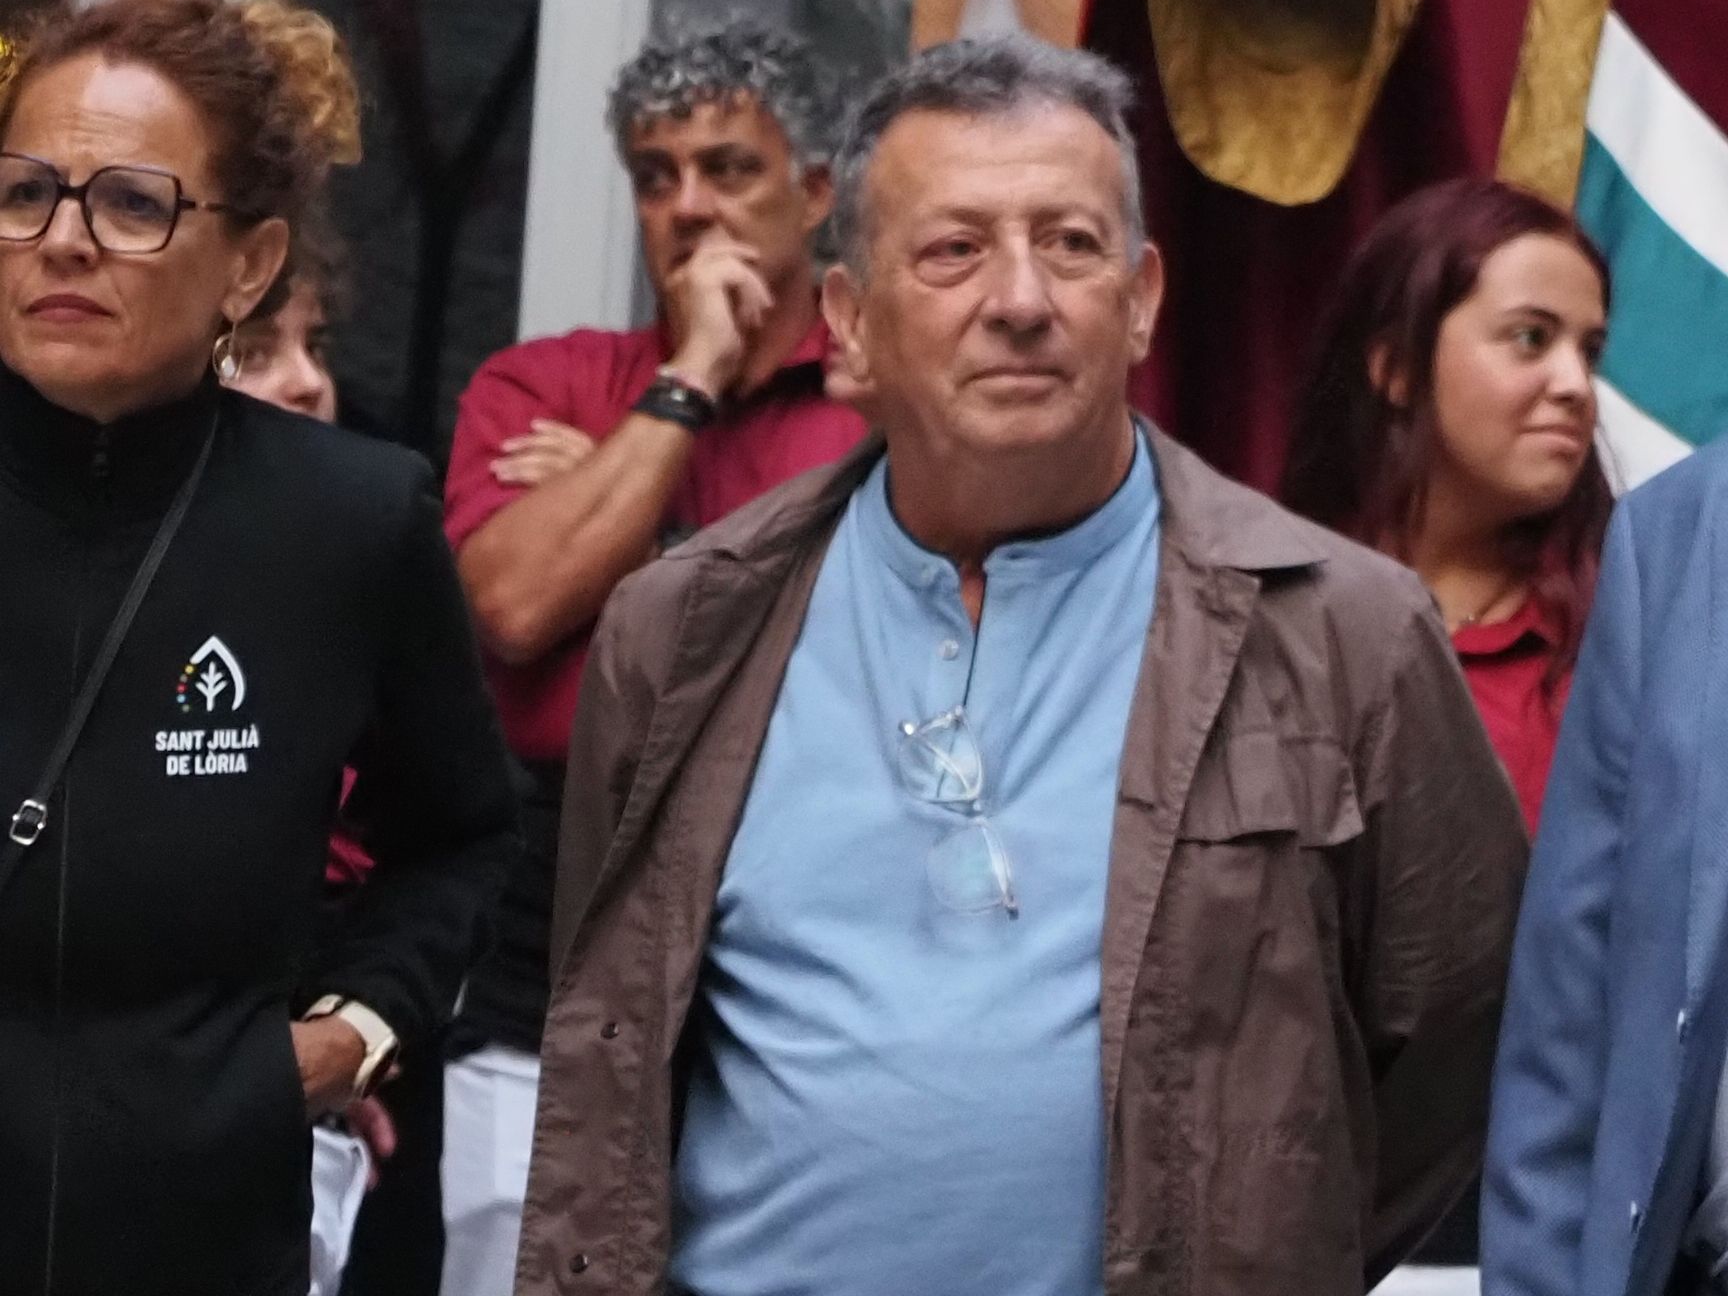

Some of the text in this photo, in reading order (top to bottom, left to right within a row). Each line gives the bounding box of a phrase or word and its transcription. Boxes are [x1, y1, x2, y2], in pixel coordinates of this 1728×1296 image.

[155, 723, 260, 752] SANT JULIÀ
[166, 749, 248, 776] DE LÒRIA
